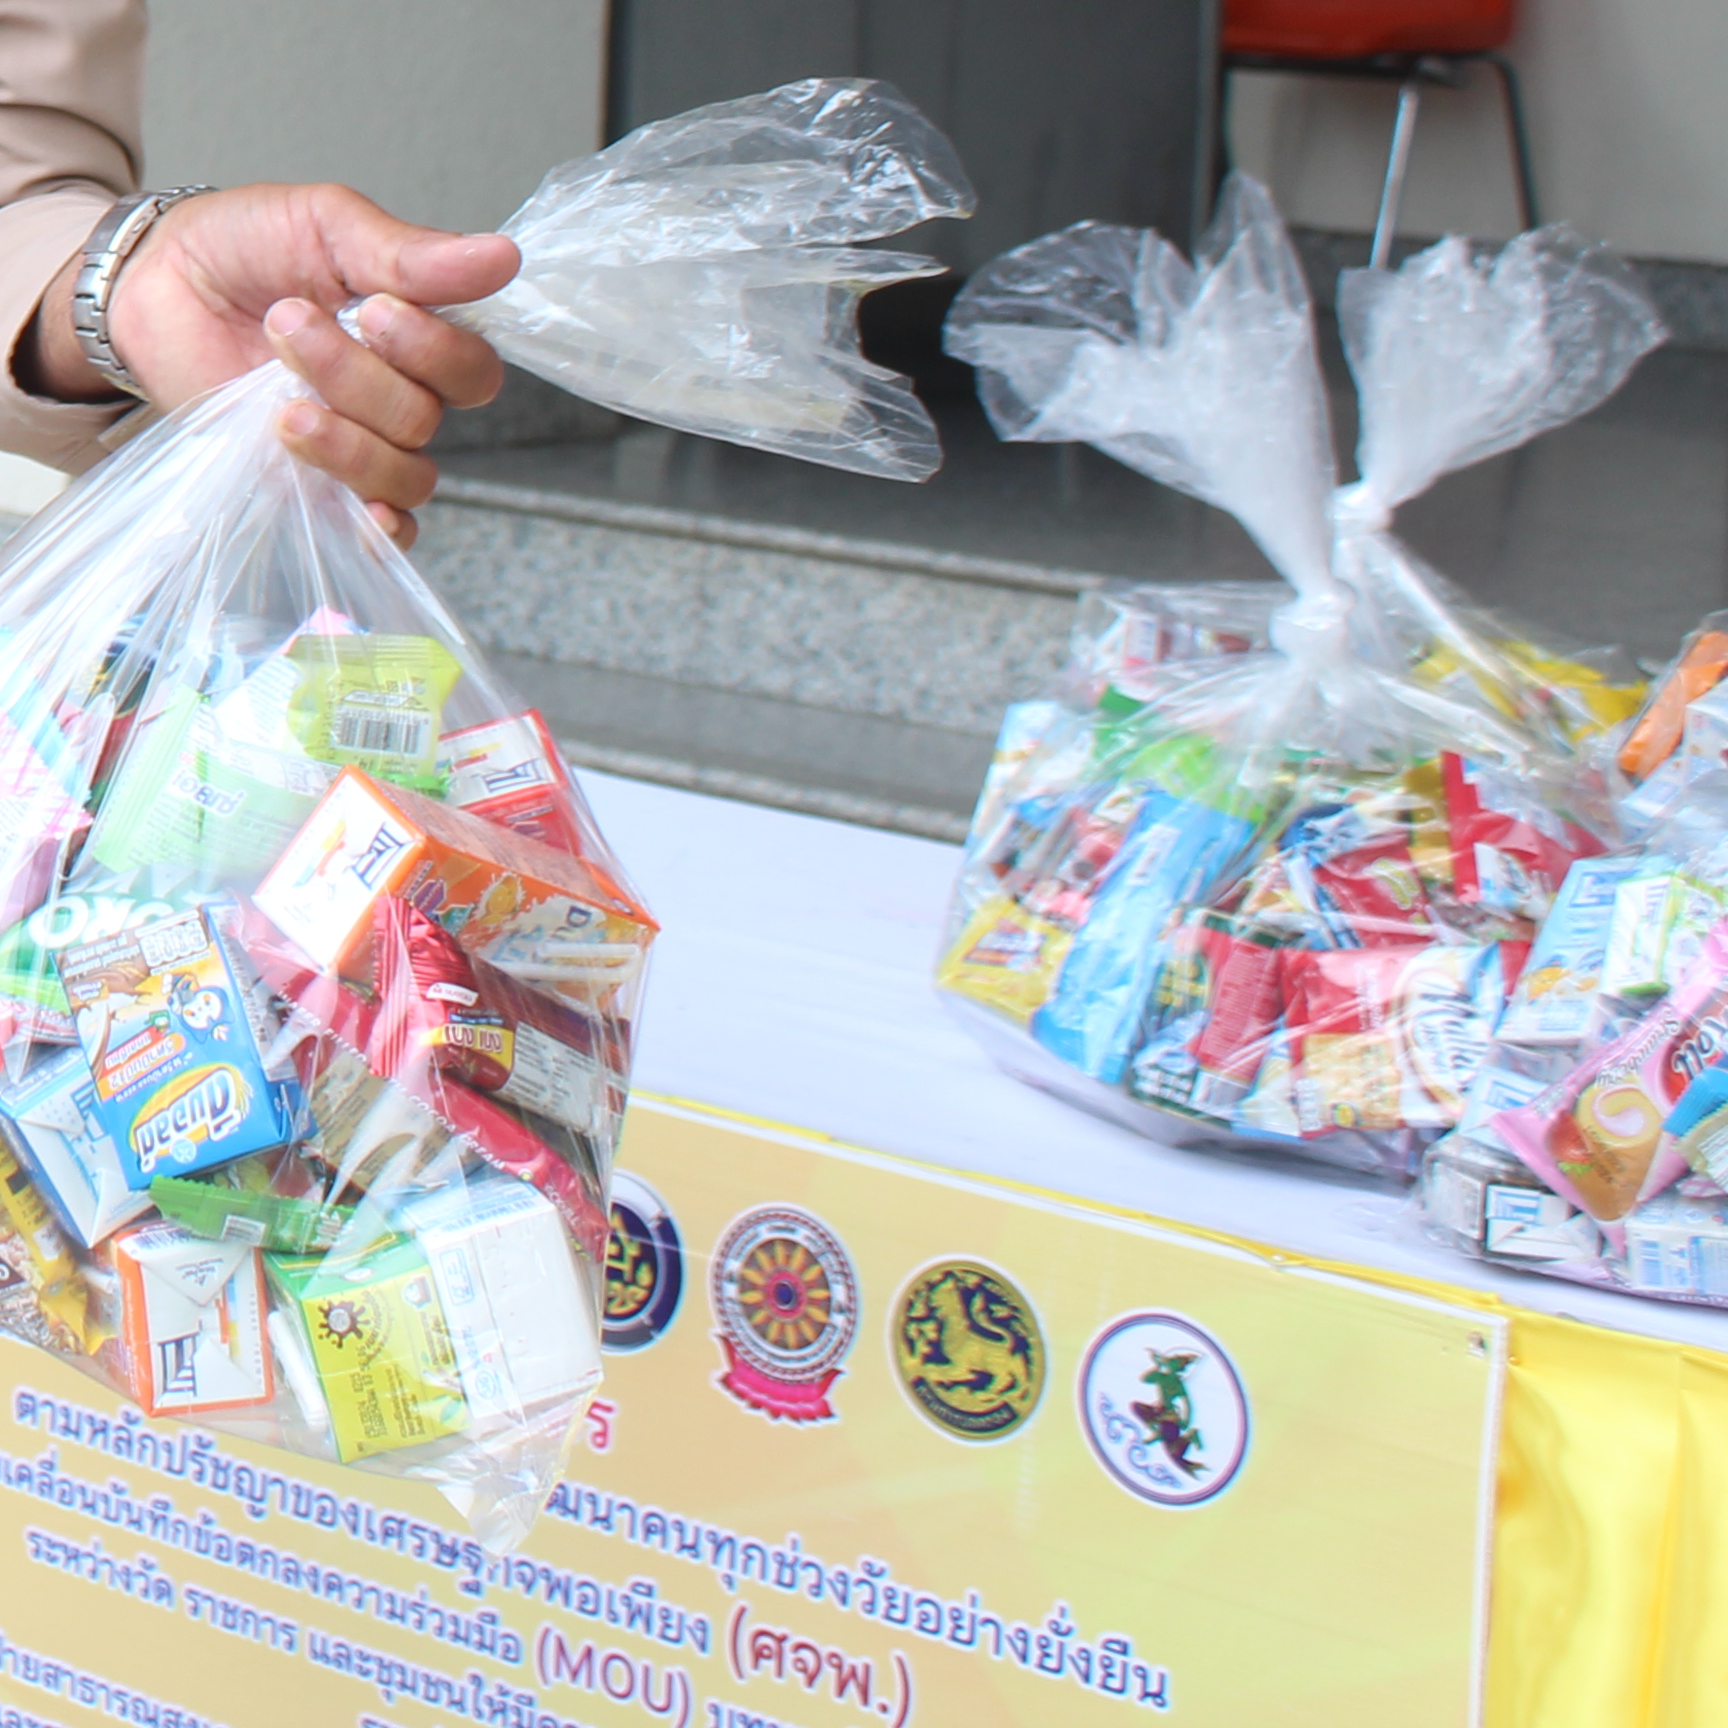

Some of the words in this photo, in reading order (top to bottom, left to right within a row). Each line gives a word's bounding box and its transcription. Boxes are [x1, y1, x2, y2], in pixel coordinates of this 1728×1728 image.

[185, 1587, 298, 1652] ราชการ
[730, 1605, 911, 1728] (ศจพ.)
[536, 1626, 689, 1728] (MOU)
